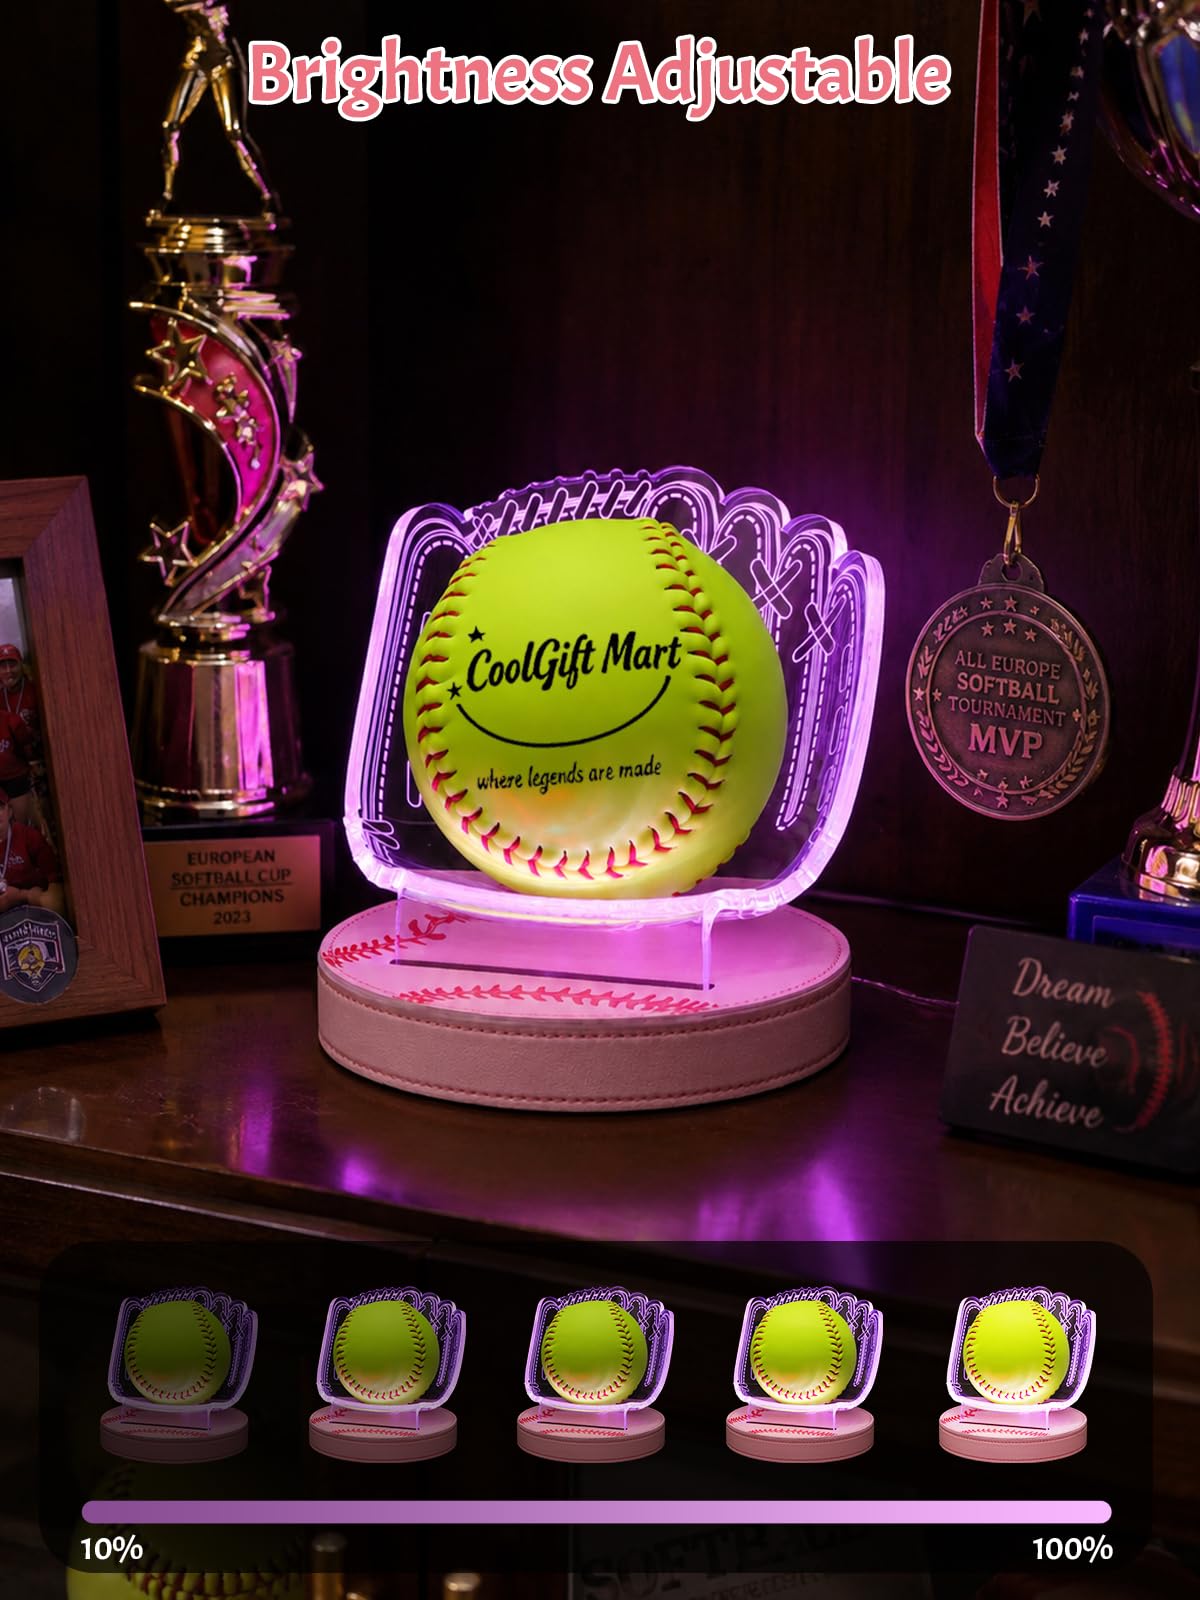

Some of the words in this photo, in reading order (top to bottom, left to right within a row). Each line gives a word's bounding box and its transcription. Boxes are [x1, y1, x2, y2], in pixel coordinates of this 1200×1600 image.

[466, 634, 596, 691] CoolGift
[601, 631, 682, 674] Mart
[954, 650, 986, 669] ALL
[991, 655, 1061, 680] EUROPE
[957, 672, 1060, 704] SOFTBALL
[948, 696, 1066, 727] TOURNAMENT
[968, 723, 1043, 759] MVP
[477, 769, 523, 790] where
[527, 762, 584, 794] legends
[589, 767, 614, 782] are
[619, 754, 662, 778] made
[187, 848, 276, 867] EUROPEAN
[172, 871, 254, 887] SOFTBALL
[257, 868, 292, 882] CUP
[180, 888, 285, 907] CHAMPIONS
[213, 911, 252, 925] 2023
[1012, 957, 1114, 1008] Dream
[1001, 1015, 1107, 1068] Believe
[989, 1074, 1104, 1129] Achieve
